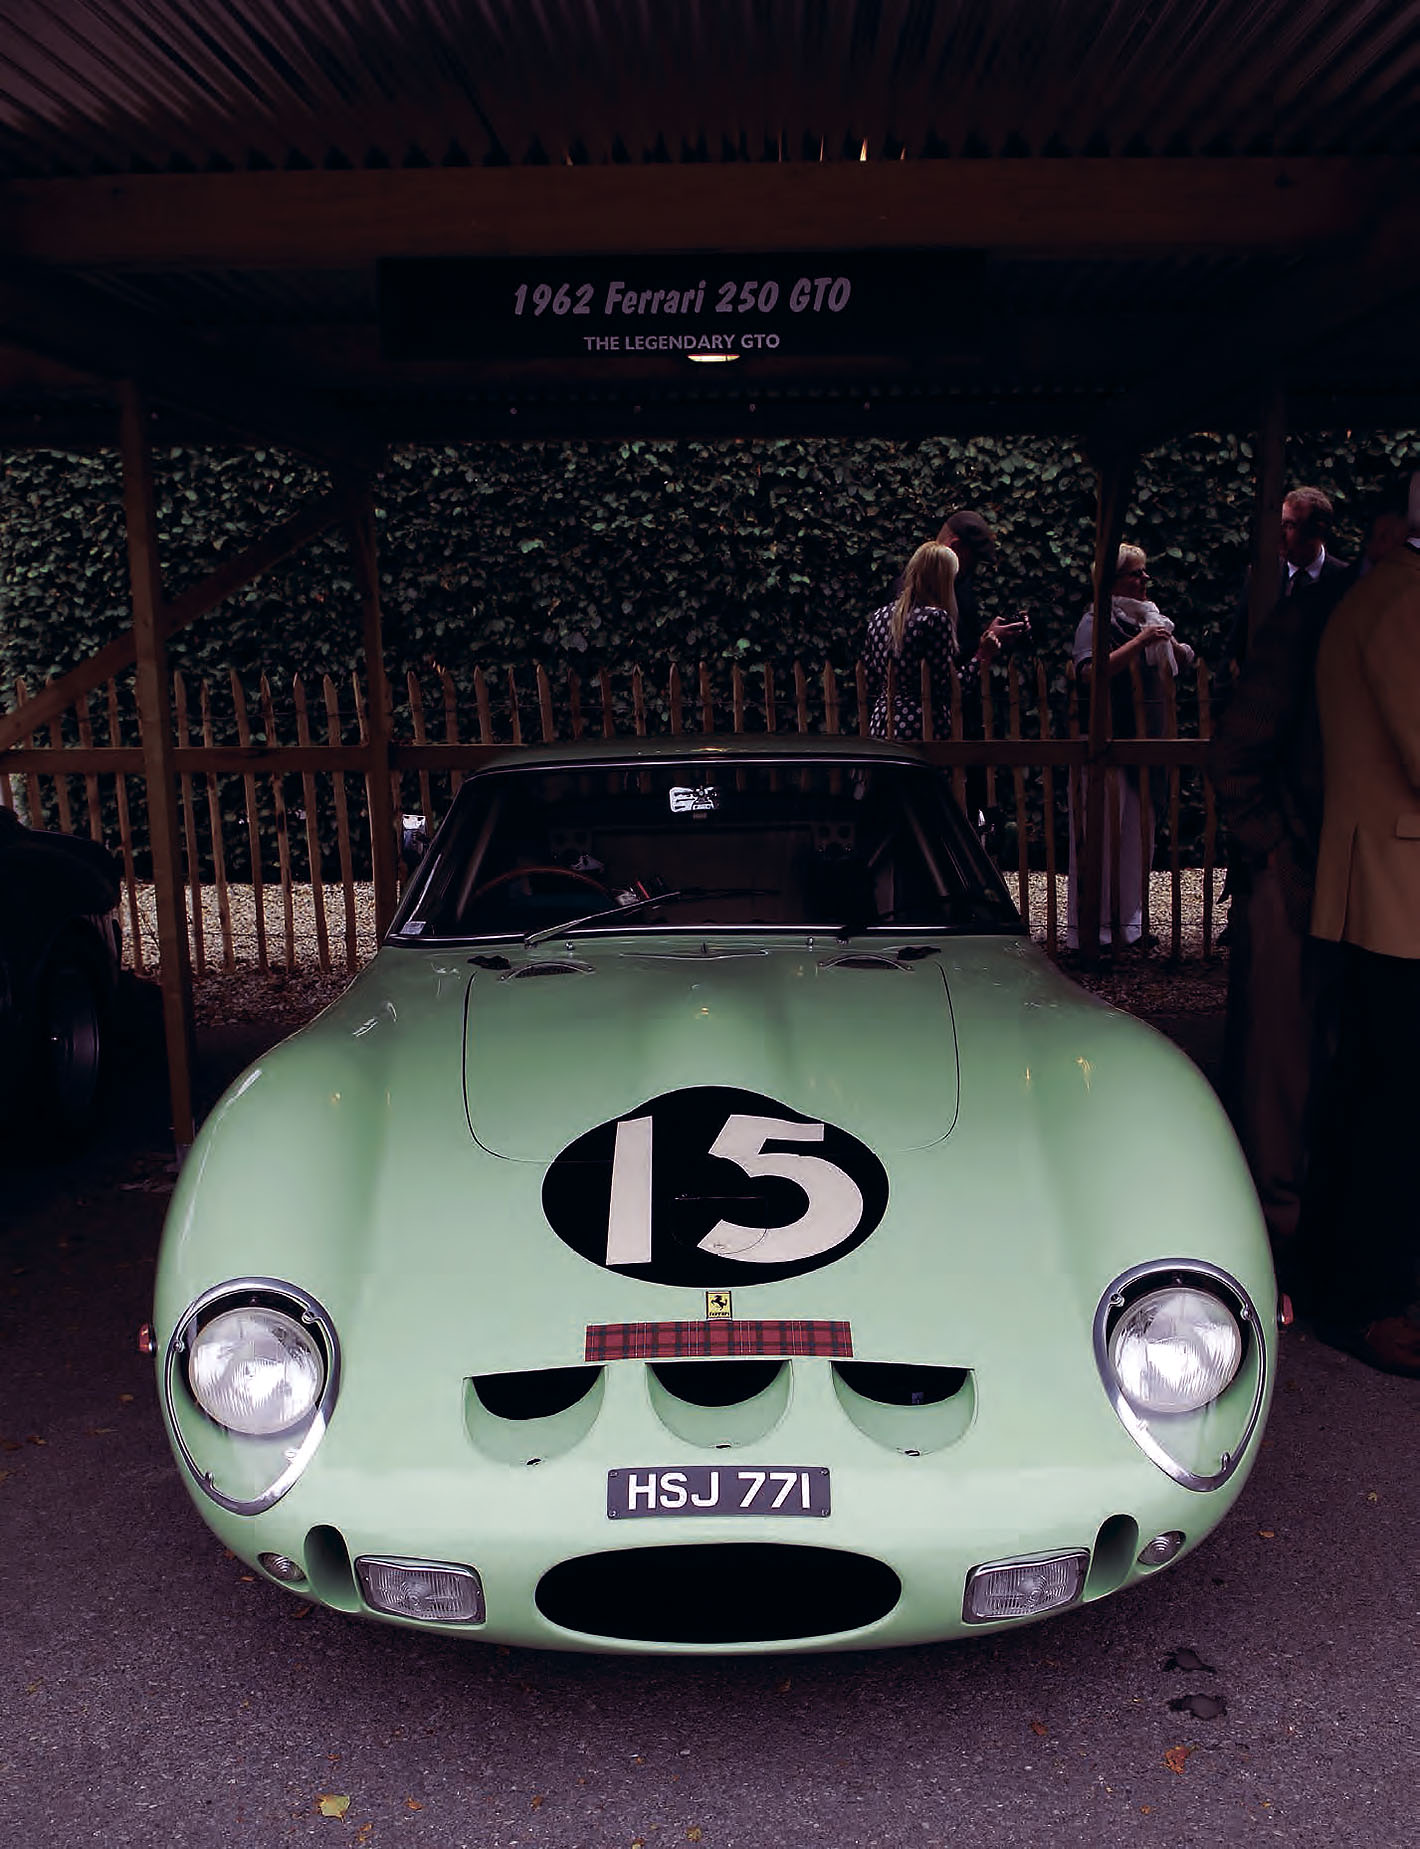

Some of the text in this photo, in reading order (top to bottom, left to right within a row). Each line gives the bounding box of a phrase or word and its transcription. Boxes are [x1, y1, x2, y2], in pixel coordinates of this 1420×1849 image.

[514, 277, 852, 316] 1962 Ferrari 250 GTO
[583, 333, 780, 351] THE LEGENDARY GTO
[605, 1114, 864, 1266] 15
[628, 1471, 811, 1510] HSJ 771
